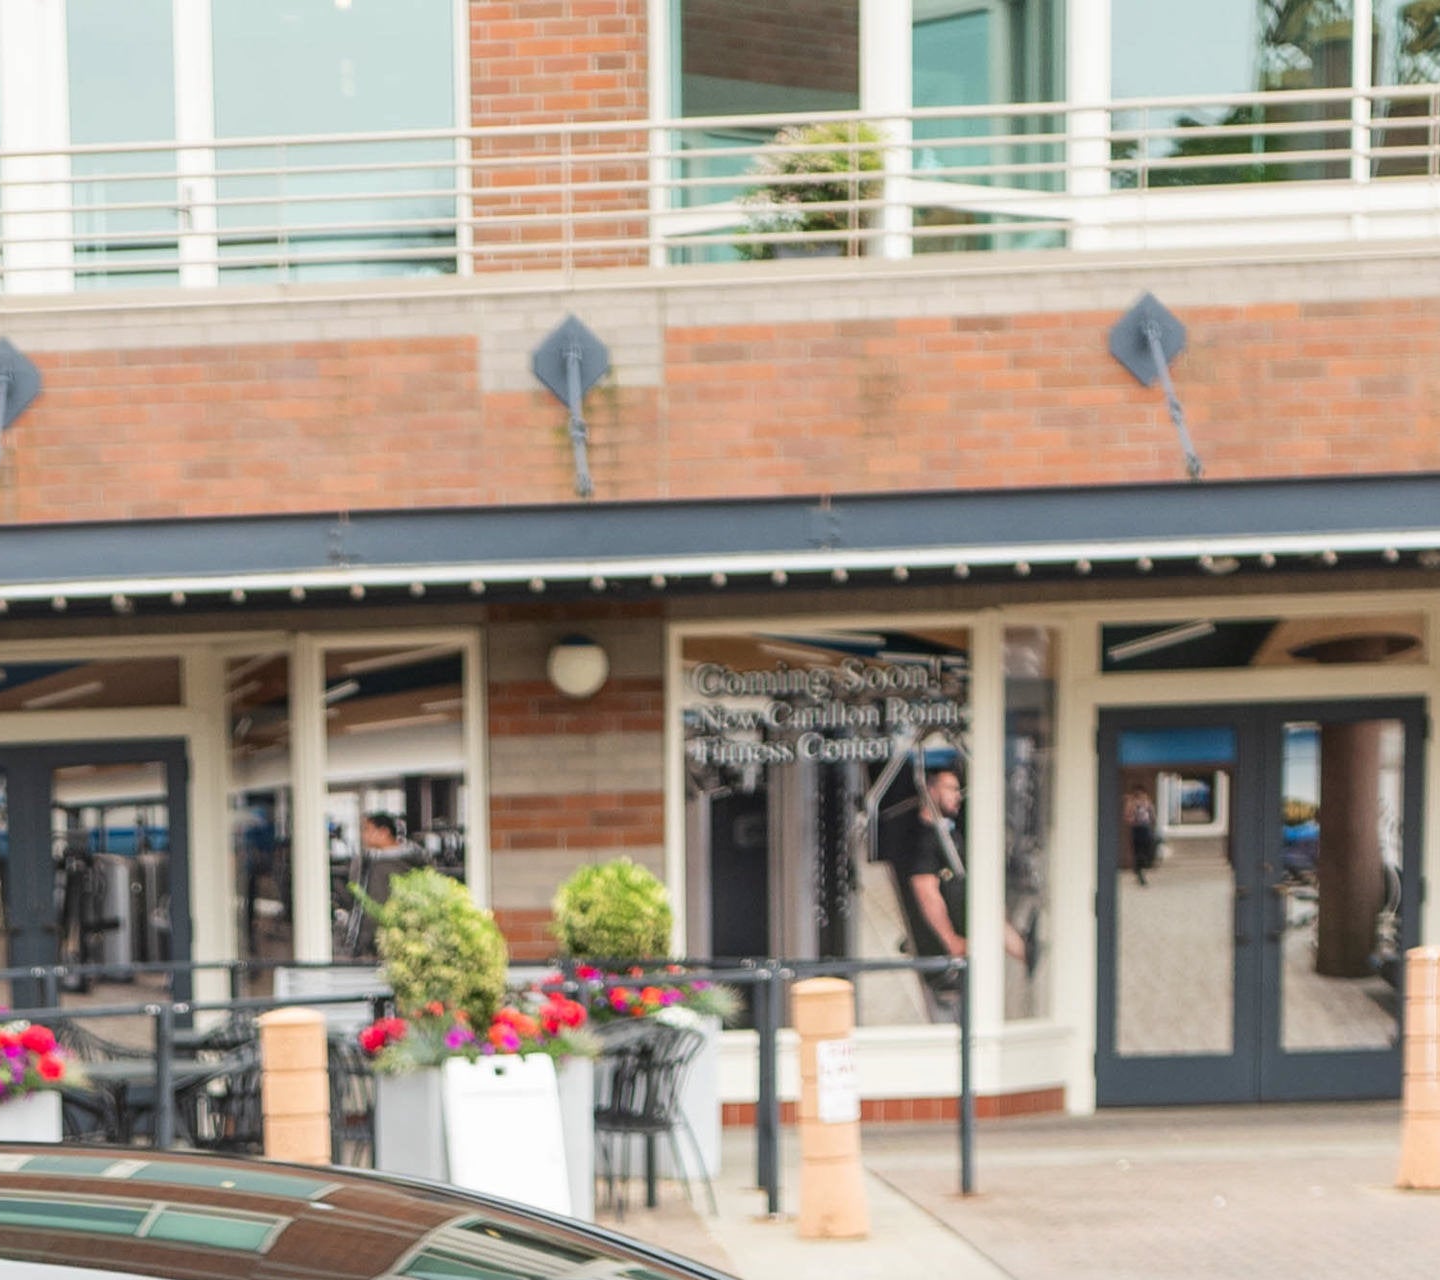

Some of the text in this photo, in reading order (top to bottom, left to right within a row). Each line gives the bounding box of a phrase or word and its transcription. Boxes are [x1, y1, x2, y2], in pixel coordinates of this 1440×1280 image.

[693, 656, 942, 700] Coming Soon!
[695, 695, 960, 732] New Carillon Point
[693, 730, 892, 764] Fitness Center
